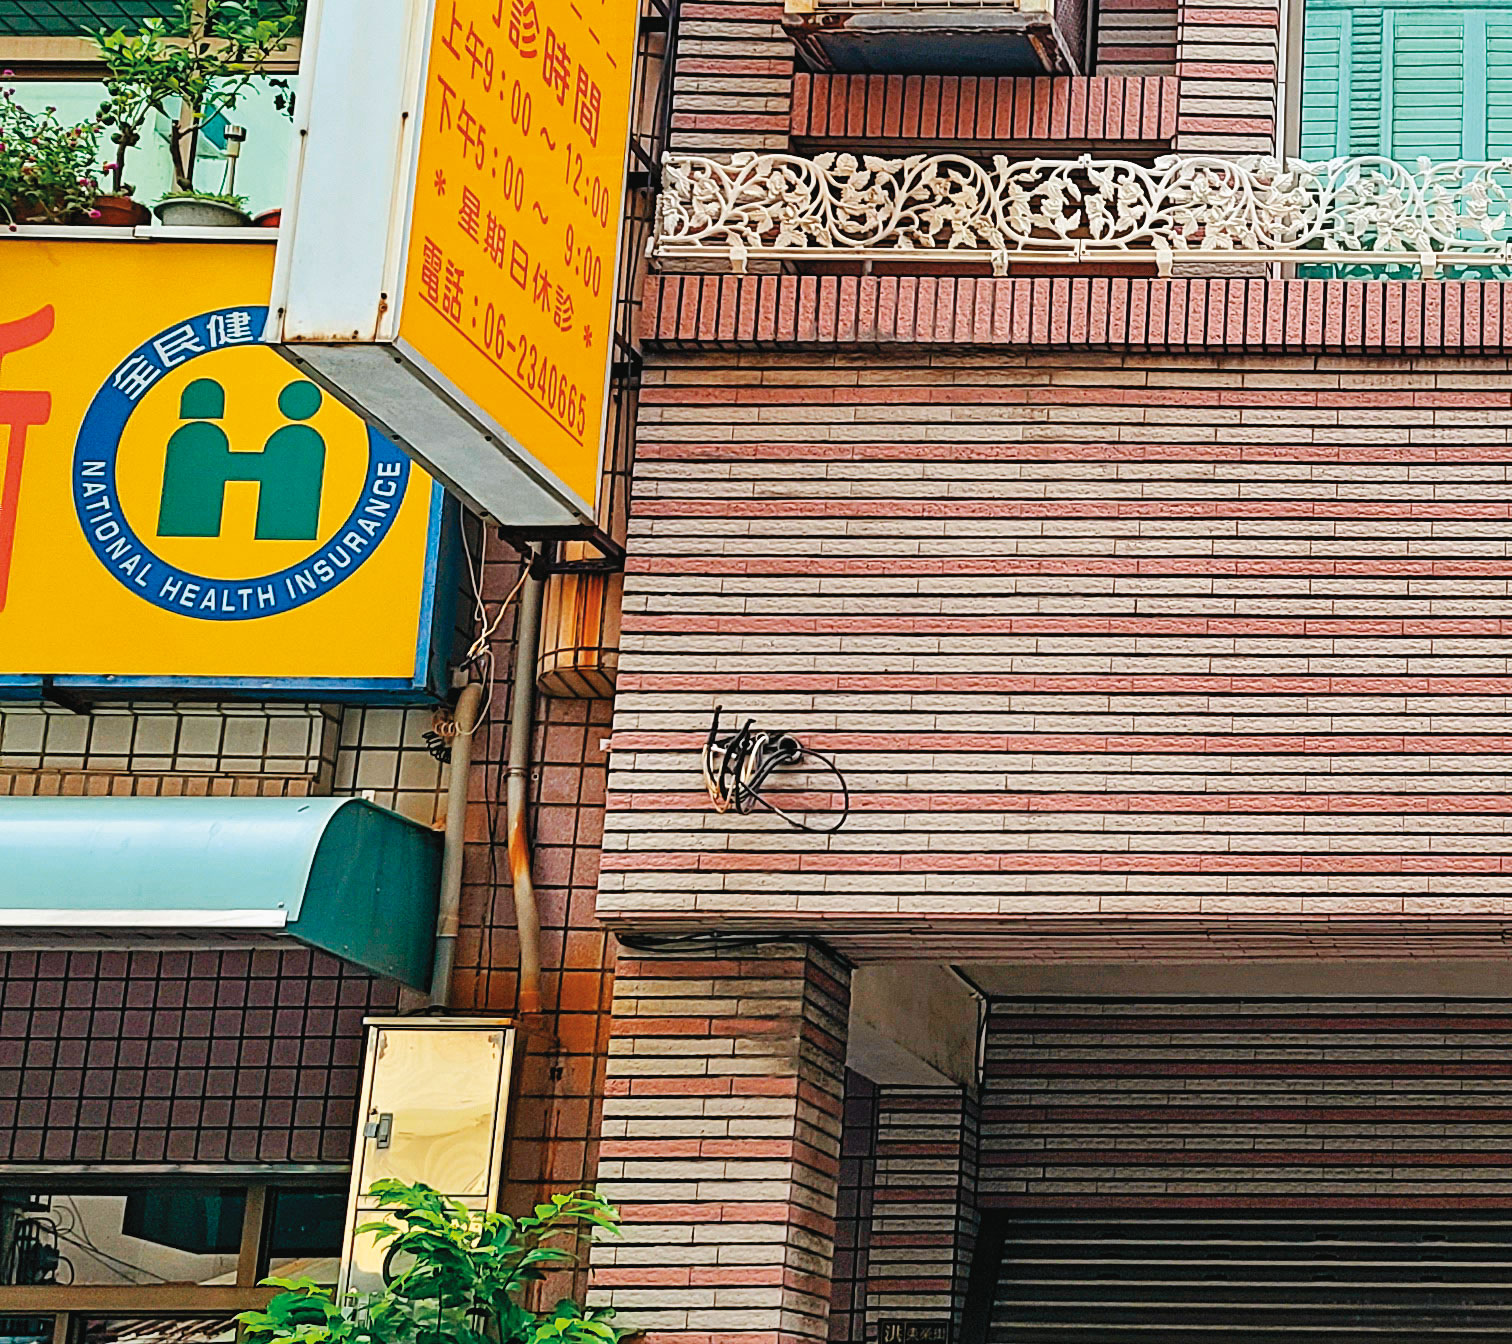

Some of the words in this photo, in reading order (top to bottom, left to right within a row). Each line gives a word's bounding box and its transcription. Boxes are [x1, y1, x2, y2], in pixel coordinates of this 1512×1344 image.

[112, 310, 270, 401] 全民健
[82, 460, 152, 588] NATIONAL
[160, 579, 276, 612] HEALTH
[286, 461, 402, 600] INSURANCE
